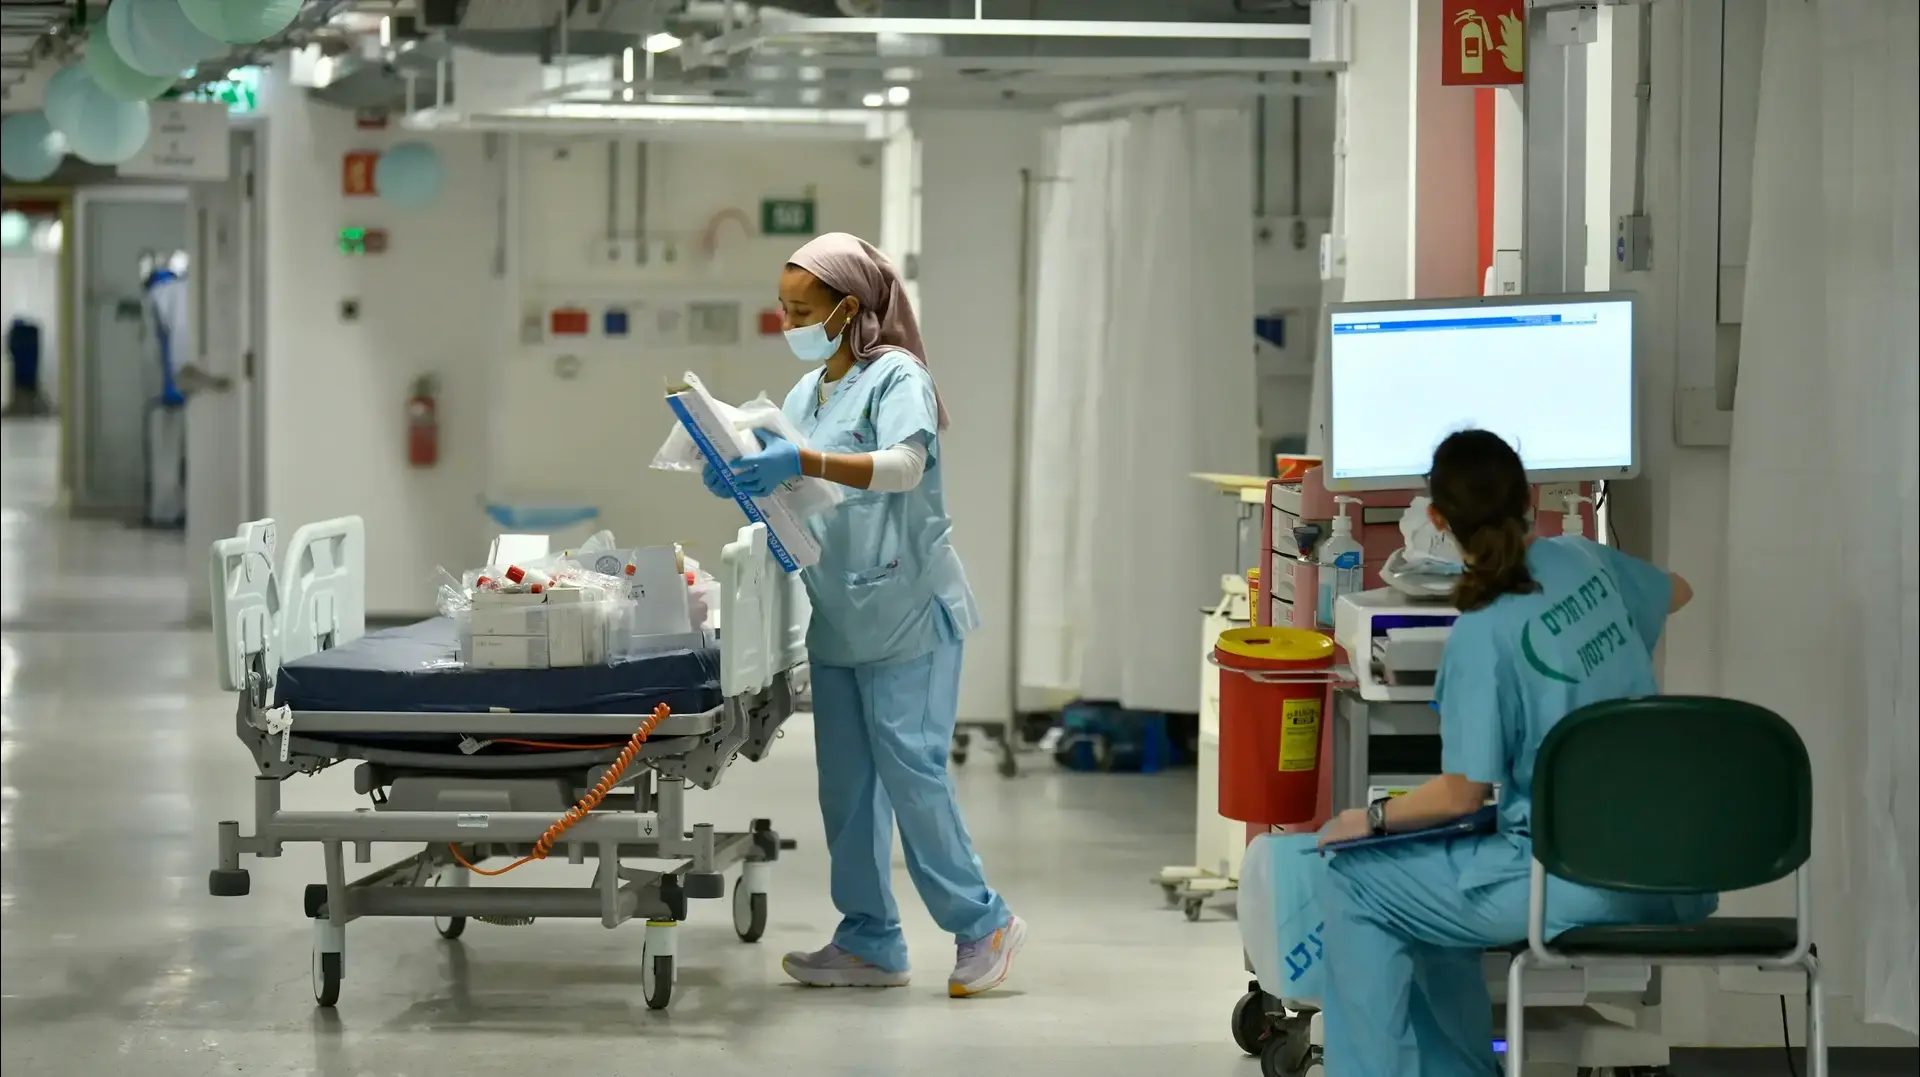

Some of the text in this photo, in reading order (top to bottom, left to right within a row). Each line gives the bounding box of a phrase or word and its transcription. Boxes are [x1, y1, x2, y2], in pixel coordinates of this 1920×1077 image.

[776, 547, 793, 568] LATEX
[1540, 575, 1609, 636] בית חולים
[1576, 621, 1627, 677] בילינסון
